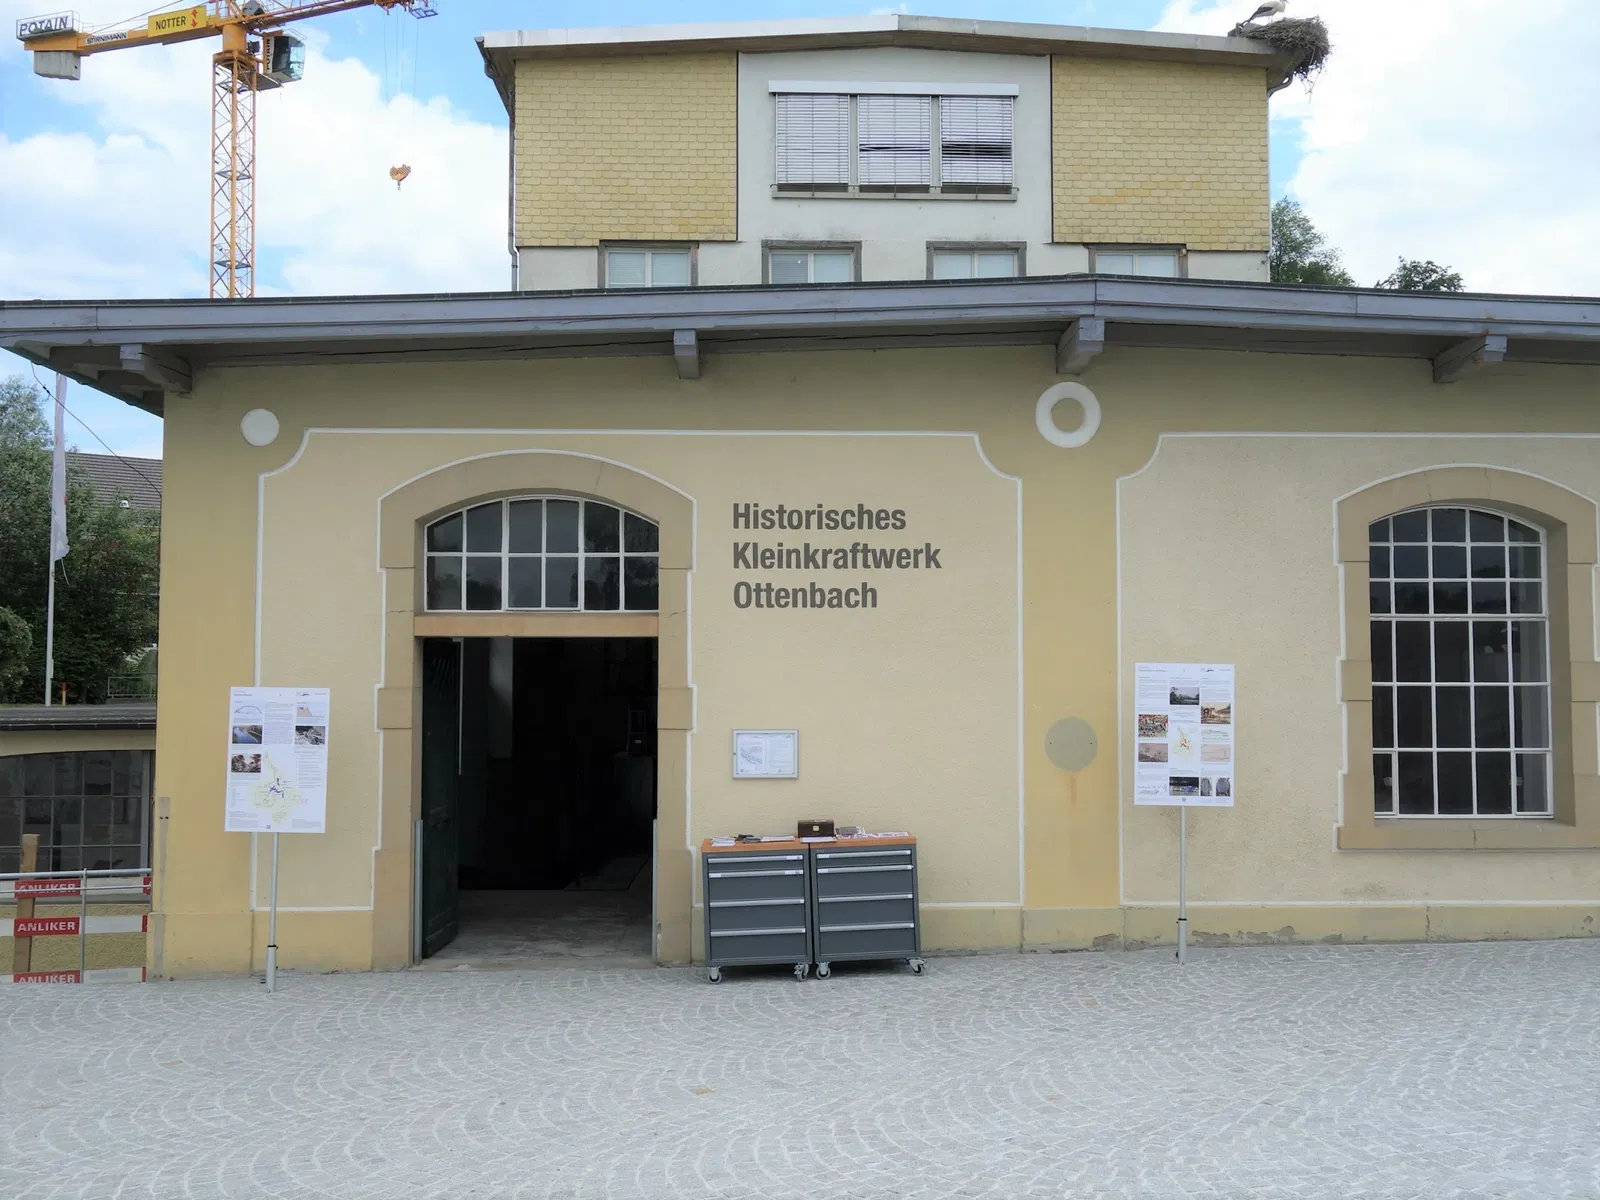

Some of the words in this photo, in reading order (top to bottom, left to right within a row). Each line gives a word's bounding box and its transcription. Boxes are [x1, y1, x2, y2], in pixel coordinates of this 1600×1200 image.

[20, 15, 68, 36] POTAIN
[155, 15, 187, 30] NOTTER
[86, 31, 127, 45] STIRNIMANN
[733, 503, 907, 530] Historisches
[733, 542, 943, 569] Kleinkraftwerk
[733, 581, 878, 609] Ottenbach
[18, 884, 76, 893] ANLIKER
[17, 921, 76, 932] ANLIKER
[18, 974, 76, 984] ANLIKER
